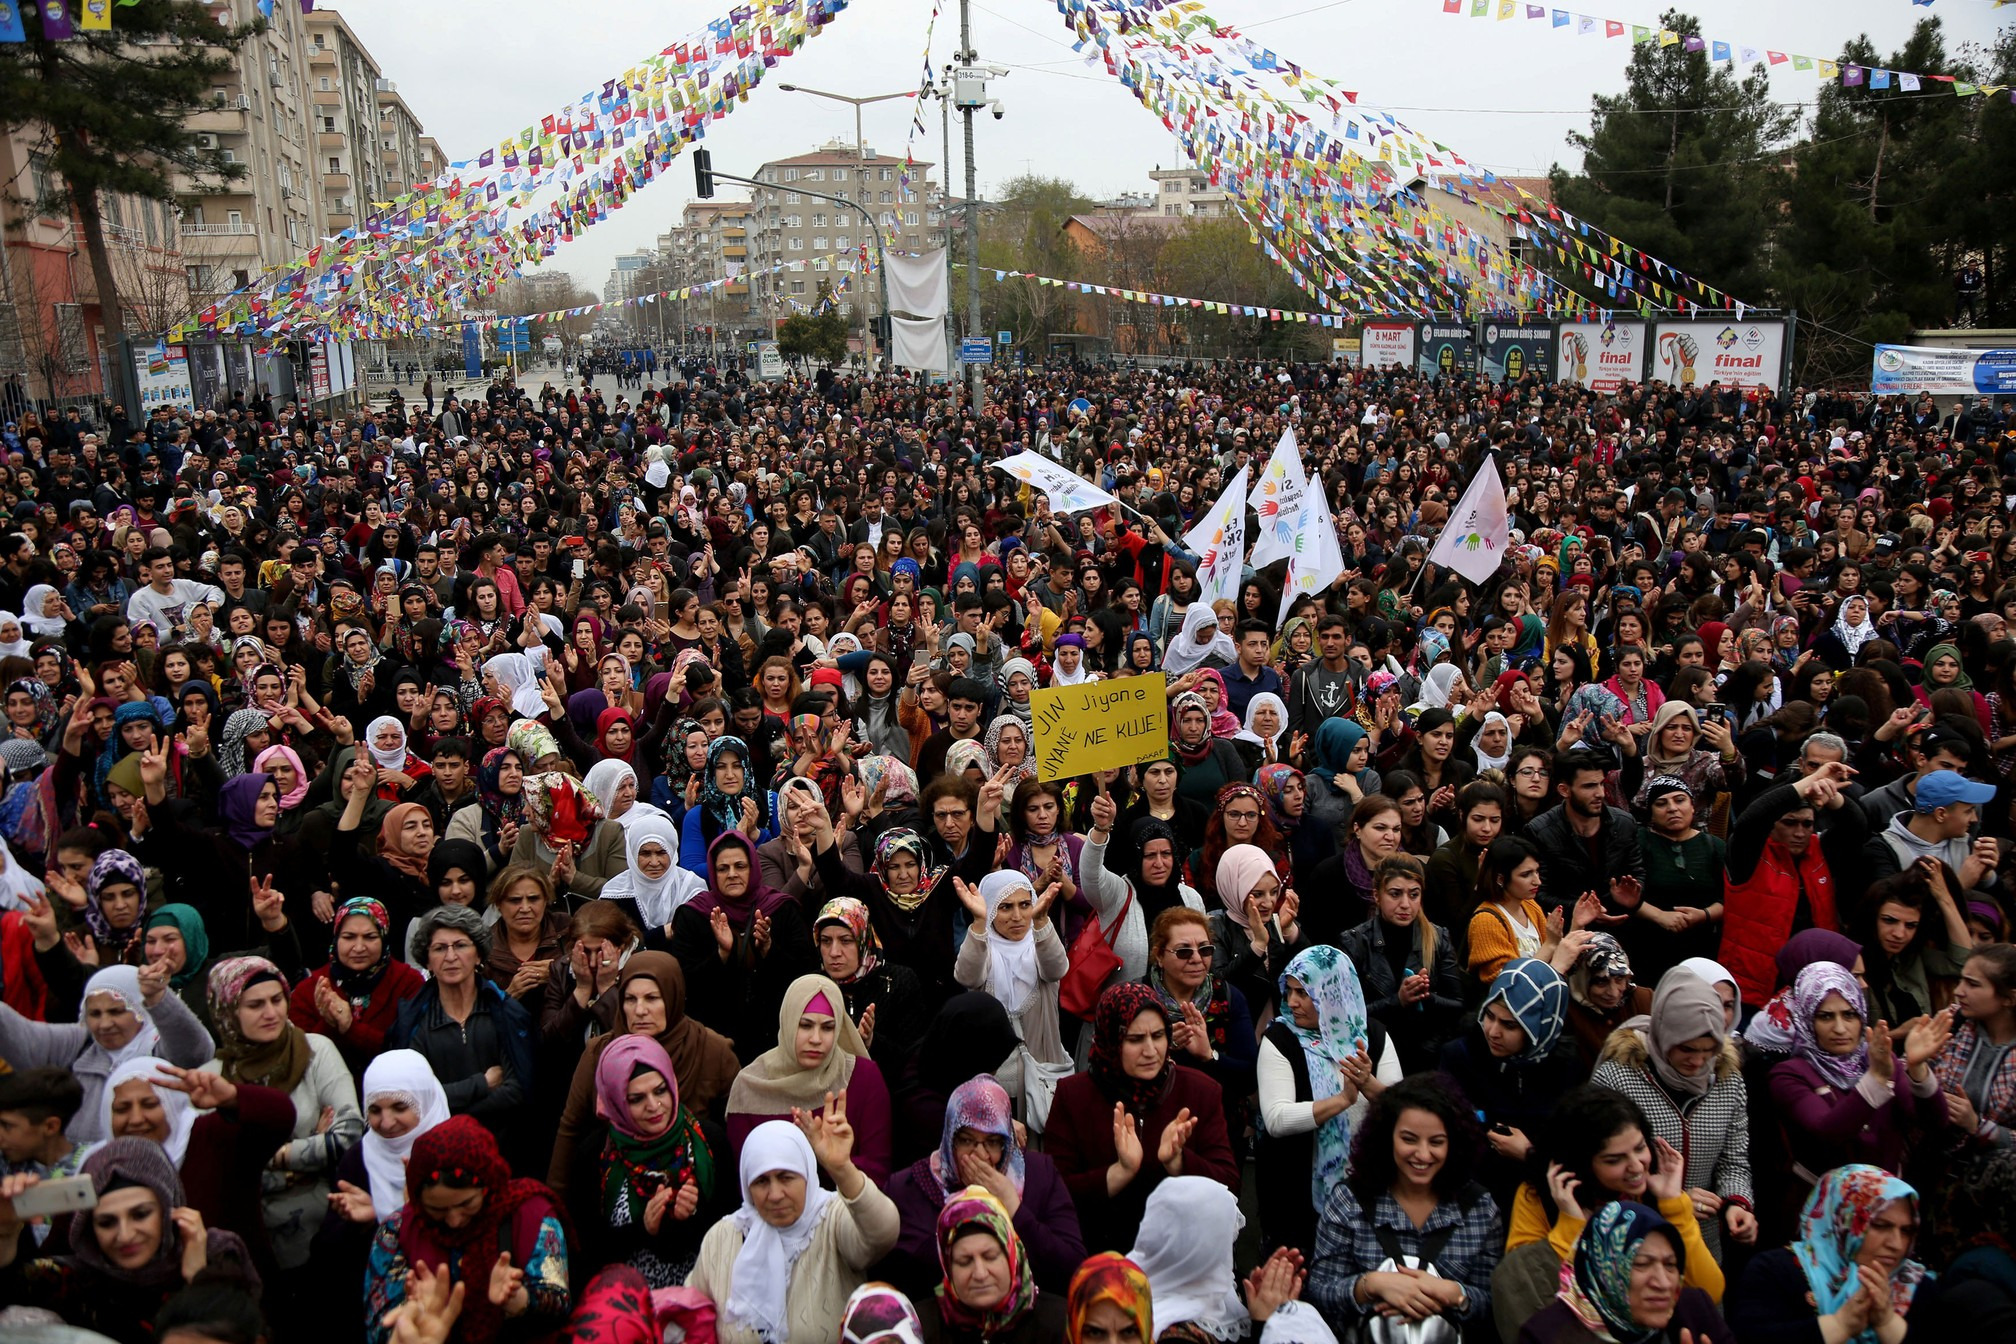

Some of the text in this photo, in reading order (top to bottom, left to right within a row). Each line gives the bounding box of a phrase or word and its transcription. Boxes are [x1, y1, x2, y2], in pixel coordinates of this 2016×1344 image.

[463, 314, 496, 322] Canon
[1375, 331, 1401, 341] 8 MART
[1600, 352, 1632, 364] final
[1715, 354, 1762, 368] final
[1037, 695, 1065, 736] JIN
[1084, 727, 1108, 748] NE
